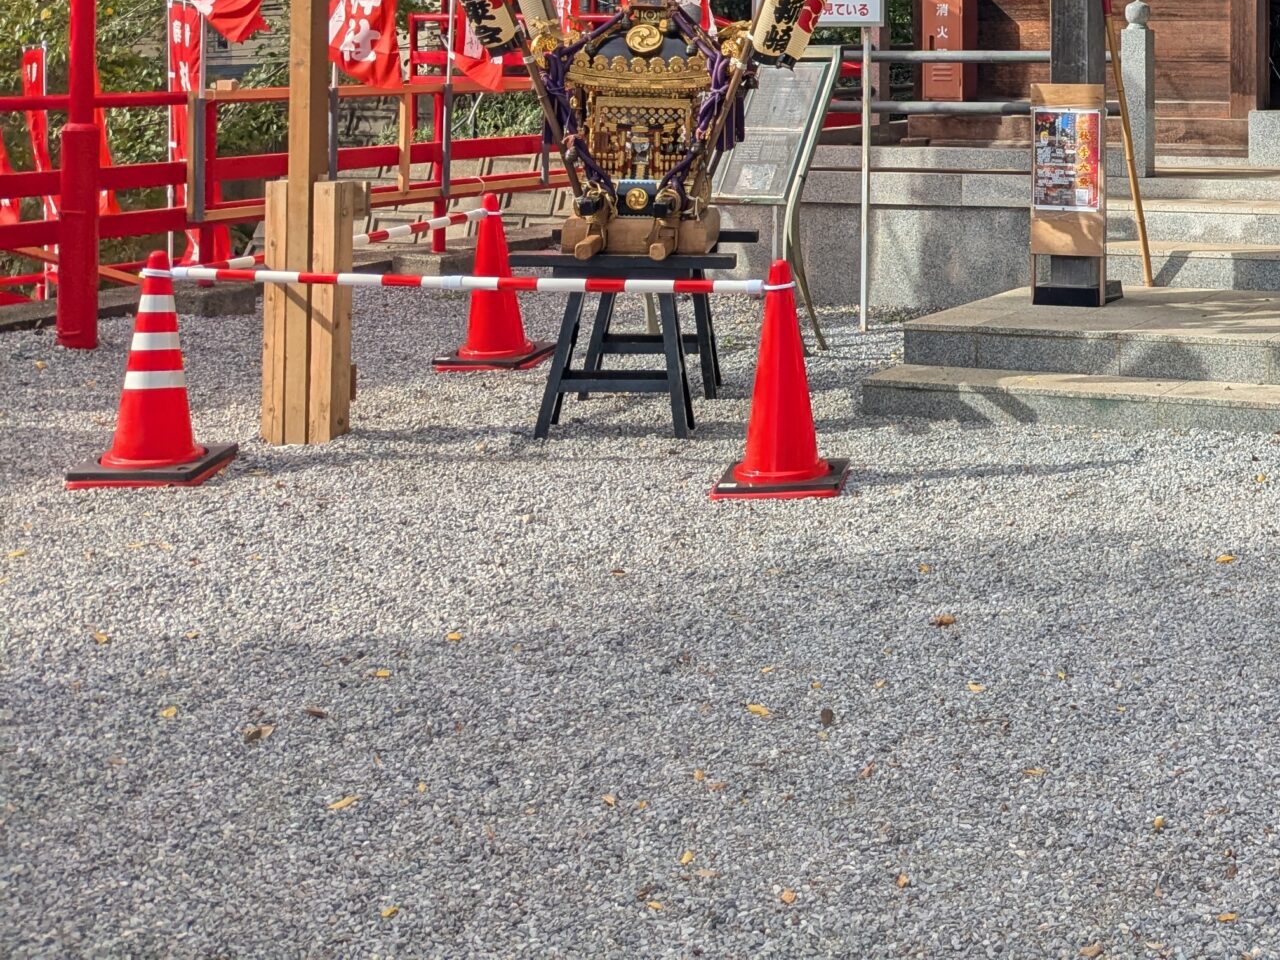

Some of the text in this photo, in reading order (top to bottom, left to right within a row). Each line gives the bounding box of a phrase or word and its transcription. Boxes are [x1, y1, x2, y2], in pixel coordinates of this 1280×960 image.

[823, 3, 869, 16] 見ている
[936, 3, 949, 52] 消火
